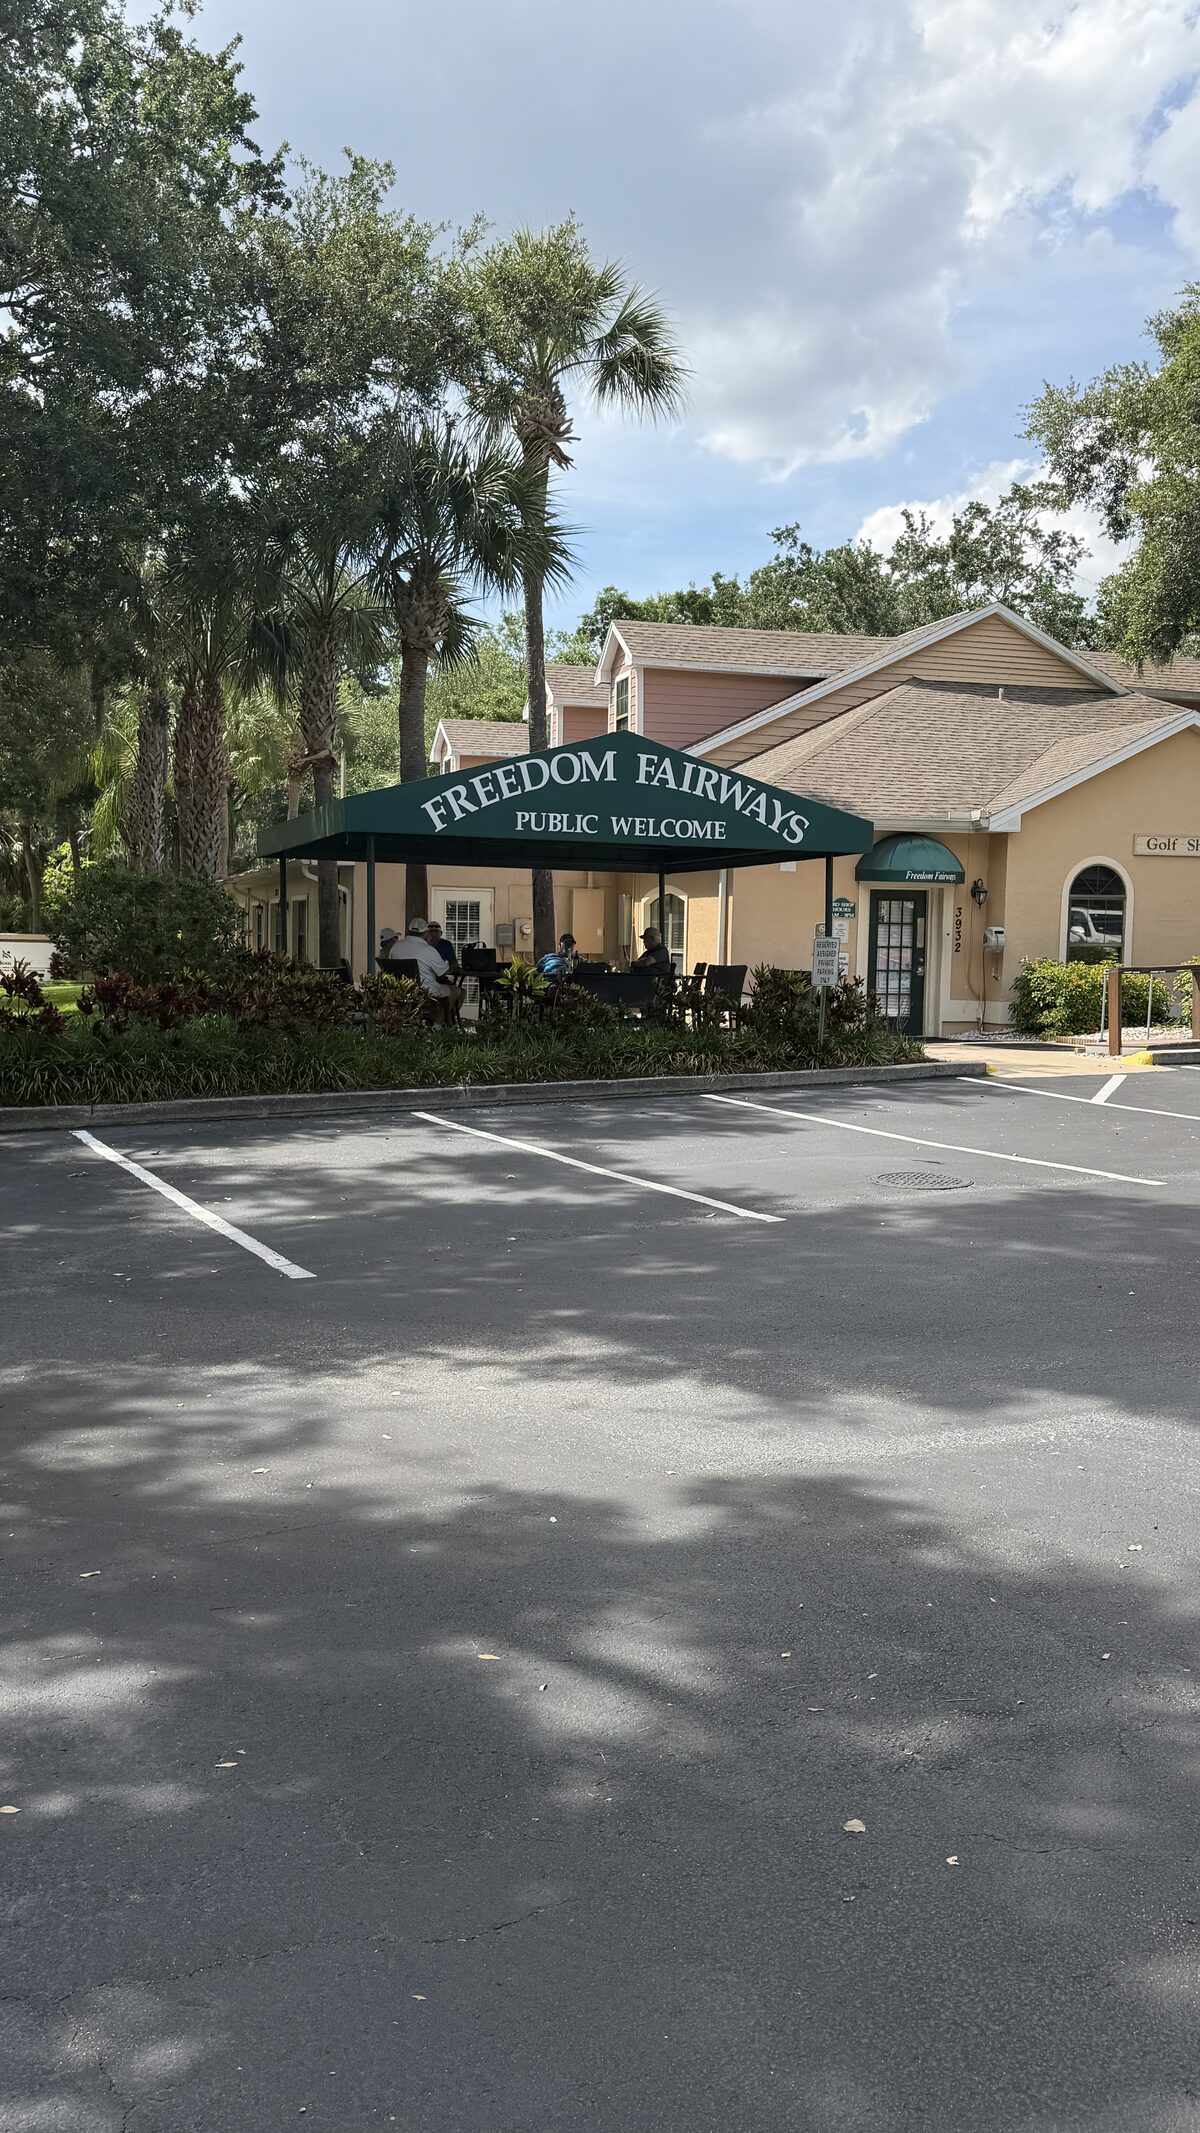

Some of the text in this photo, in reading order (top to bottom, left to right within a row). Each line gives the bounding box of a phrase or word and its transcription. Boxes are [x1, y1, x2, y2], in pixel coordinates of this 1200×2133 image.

[420, 750, 810, 845] FREEDOM FAIRWAYS
[515, 811, 727, 840] PUBLIC WELCOME
[1146, 837, 1179, 851] Golf
[905, 870, 957, 883] Freedom Fairways
[954, 907, 963, 953] 3932
[816, 941, 838, 949] RESERVED
[818, 959, 834, 967] PRIVATE
